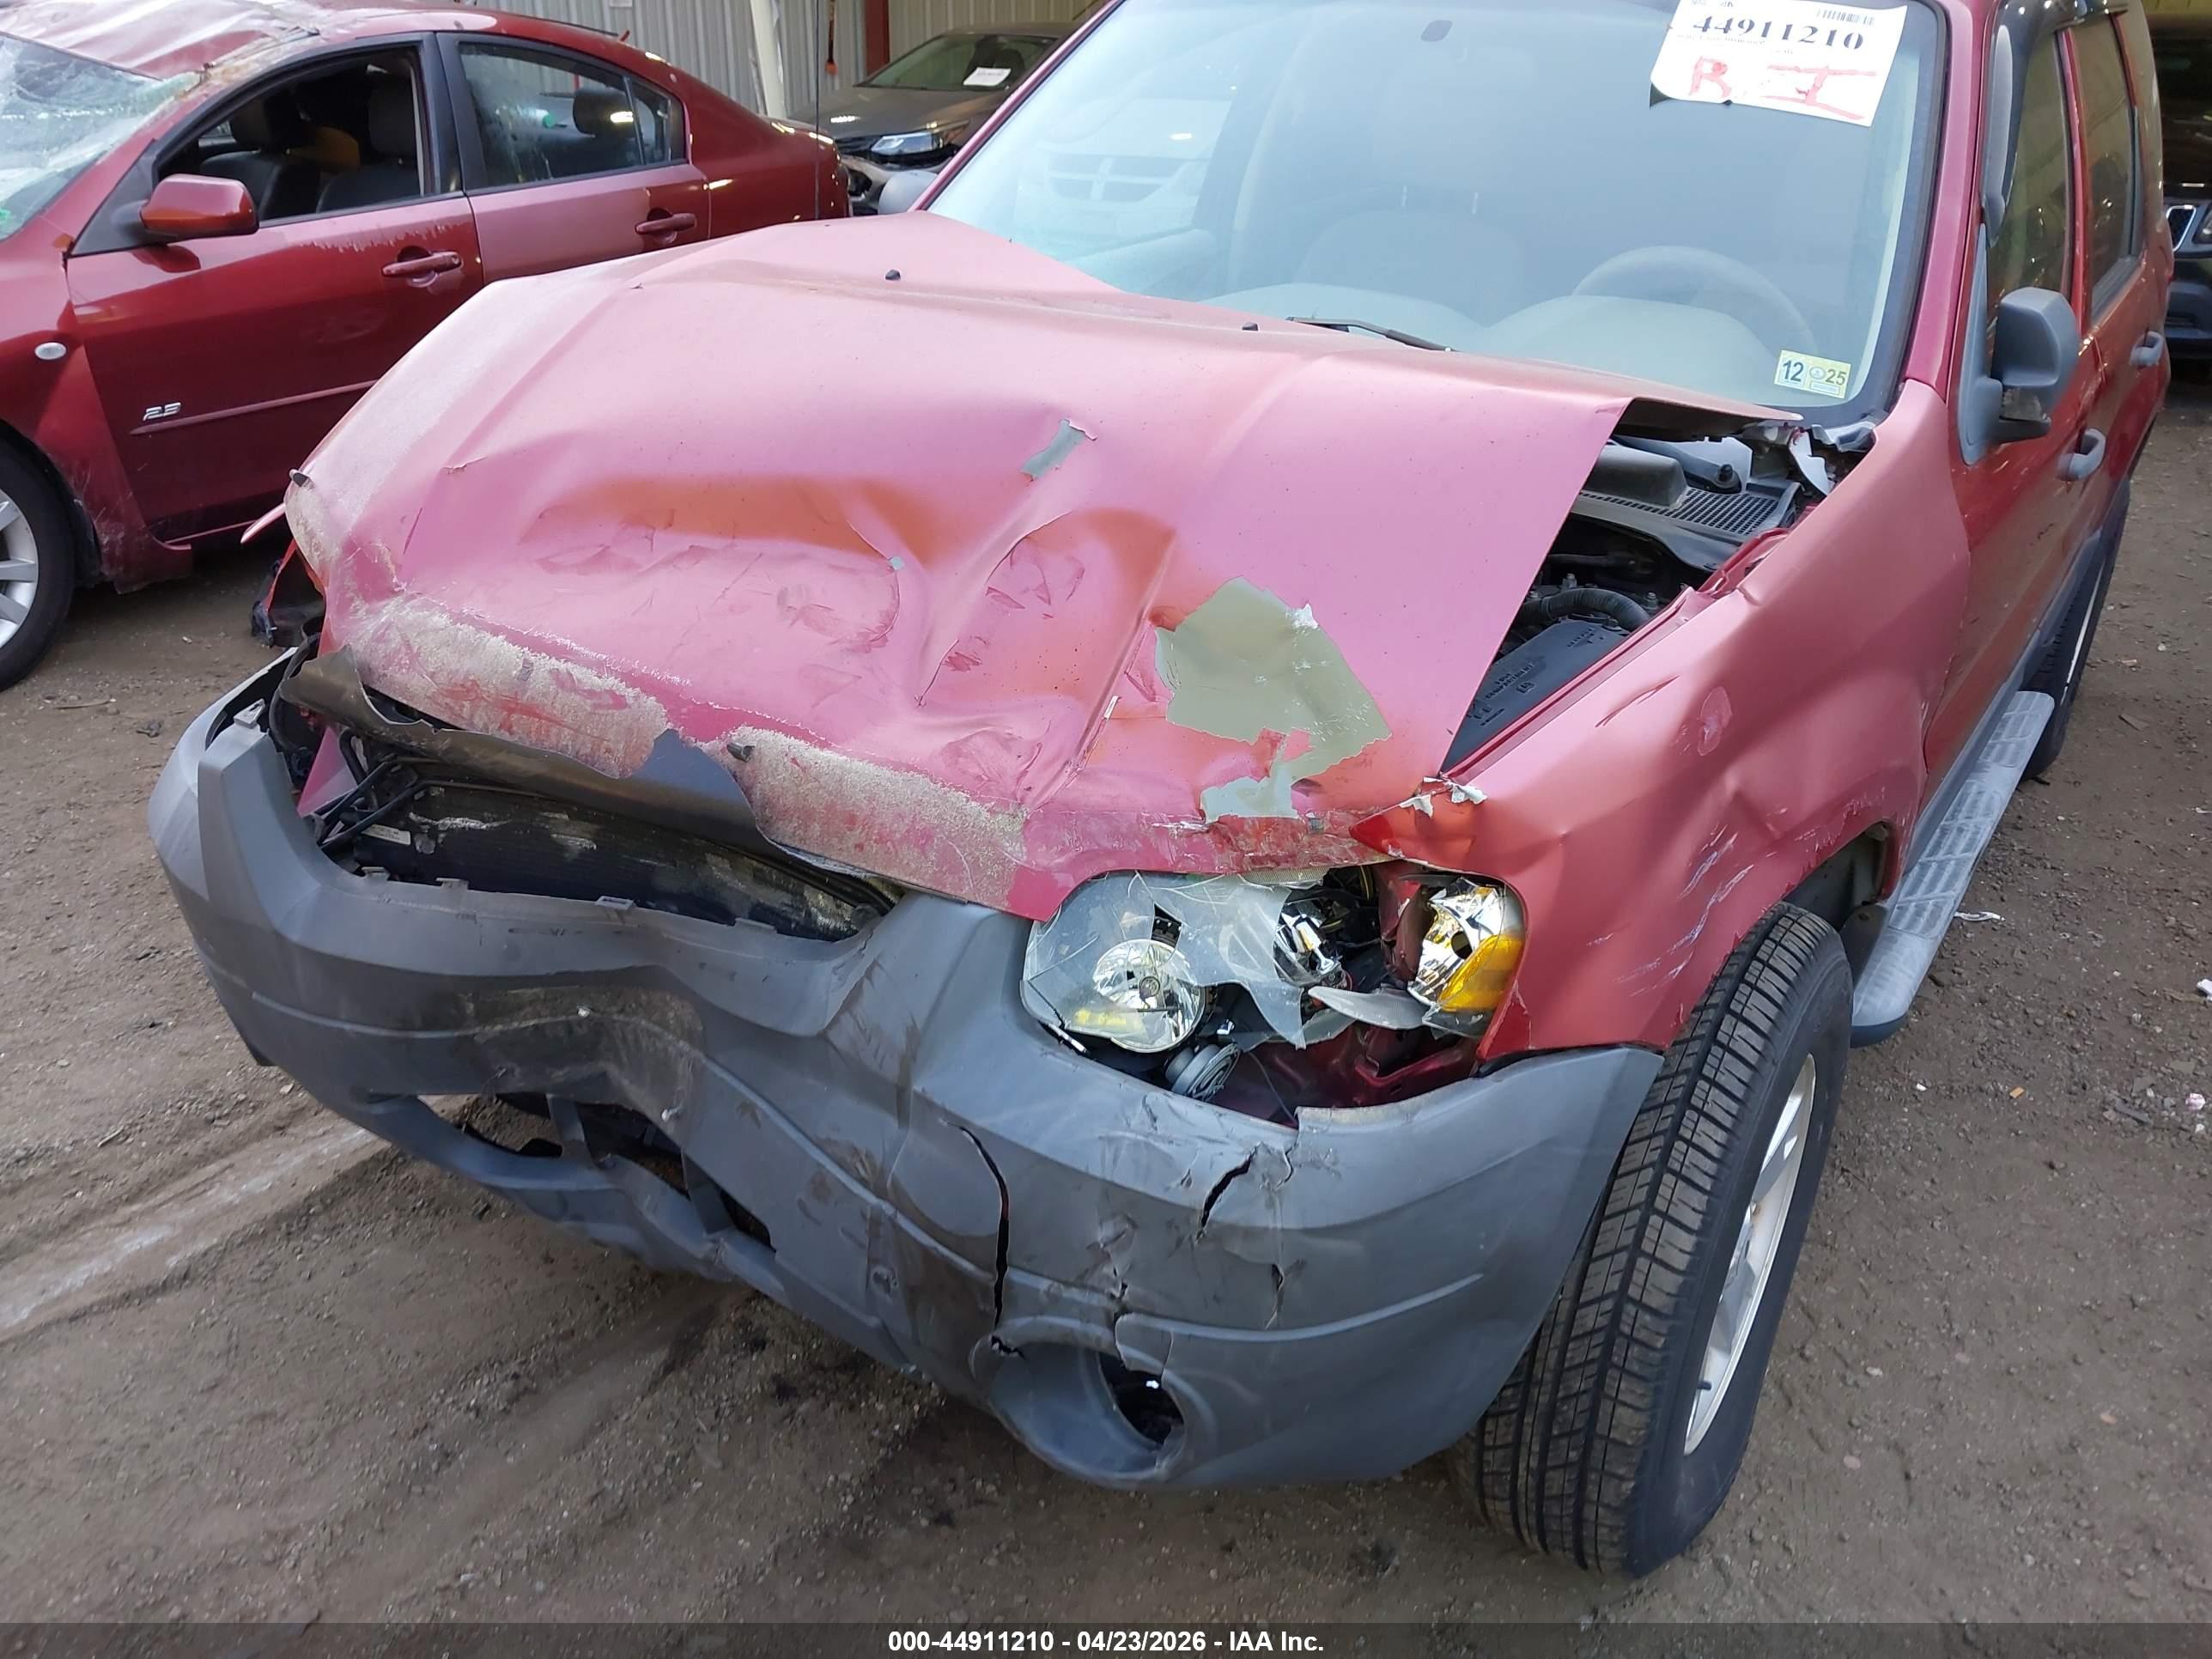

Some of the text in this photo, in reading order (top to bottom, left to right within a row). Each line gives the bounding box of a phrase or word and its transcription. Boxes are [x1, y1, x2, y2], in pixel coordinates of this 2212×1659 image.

[1692, 15, 1864, 51] 44911210
[1687, 56, 1732, 98] R
[1782, 360, 1847, 386] 12 25
